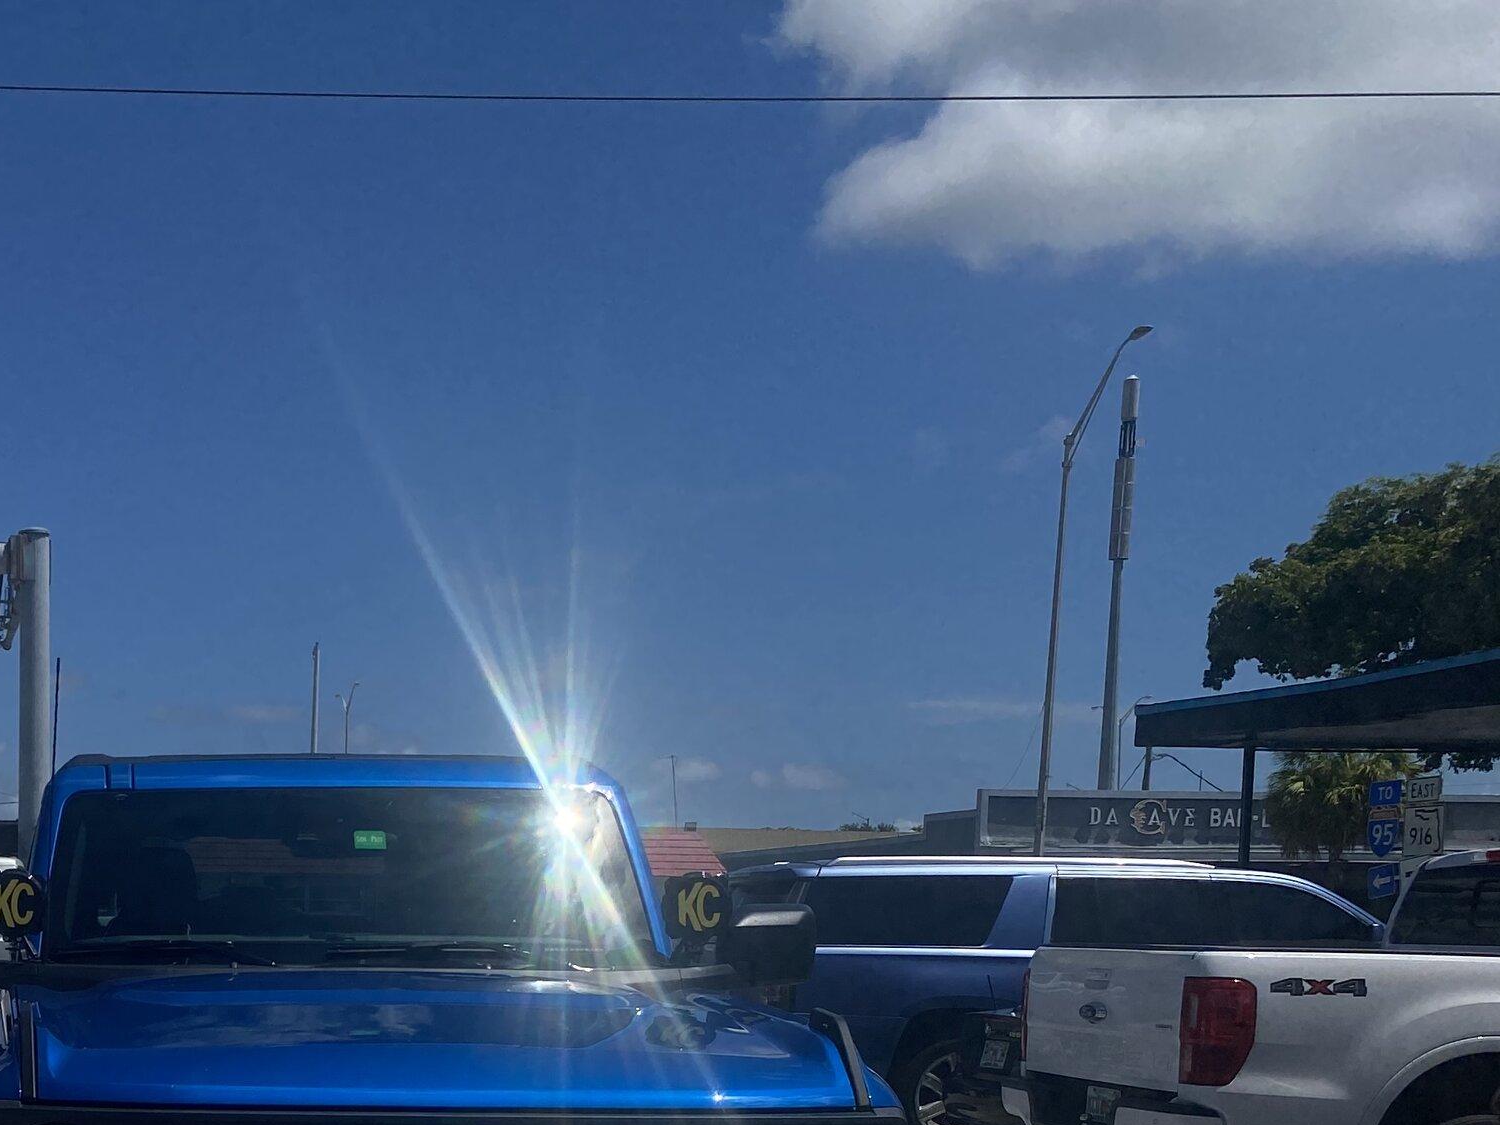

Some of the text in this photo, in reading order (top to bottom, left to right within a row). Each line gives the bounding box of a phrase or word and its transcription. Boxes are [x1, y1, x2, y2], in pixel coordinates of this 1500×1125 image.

[1378, 786, 1393, 800] TO
[1411, 783, 1435, 799] EAST
[1089, 807, 1119, 825] DA
[1372, 824, 1393, 846] 95
[1409, 827, 1432, 845] 916
[678, 882, 721, 931] KC
